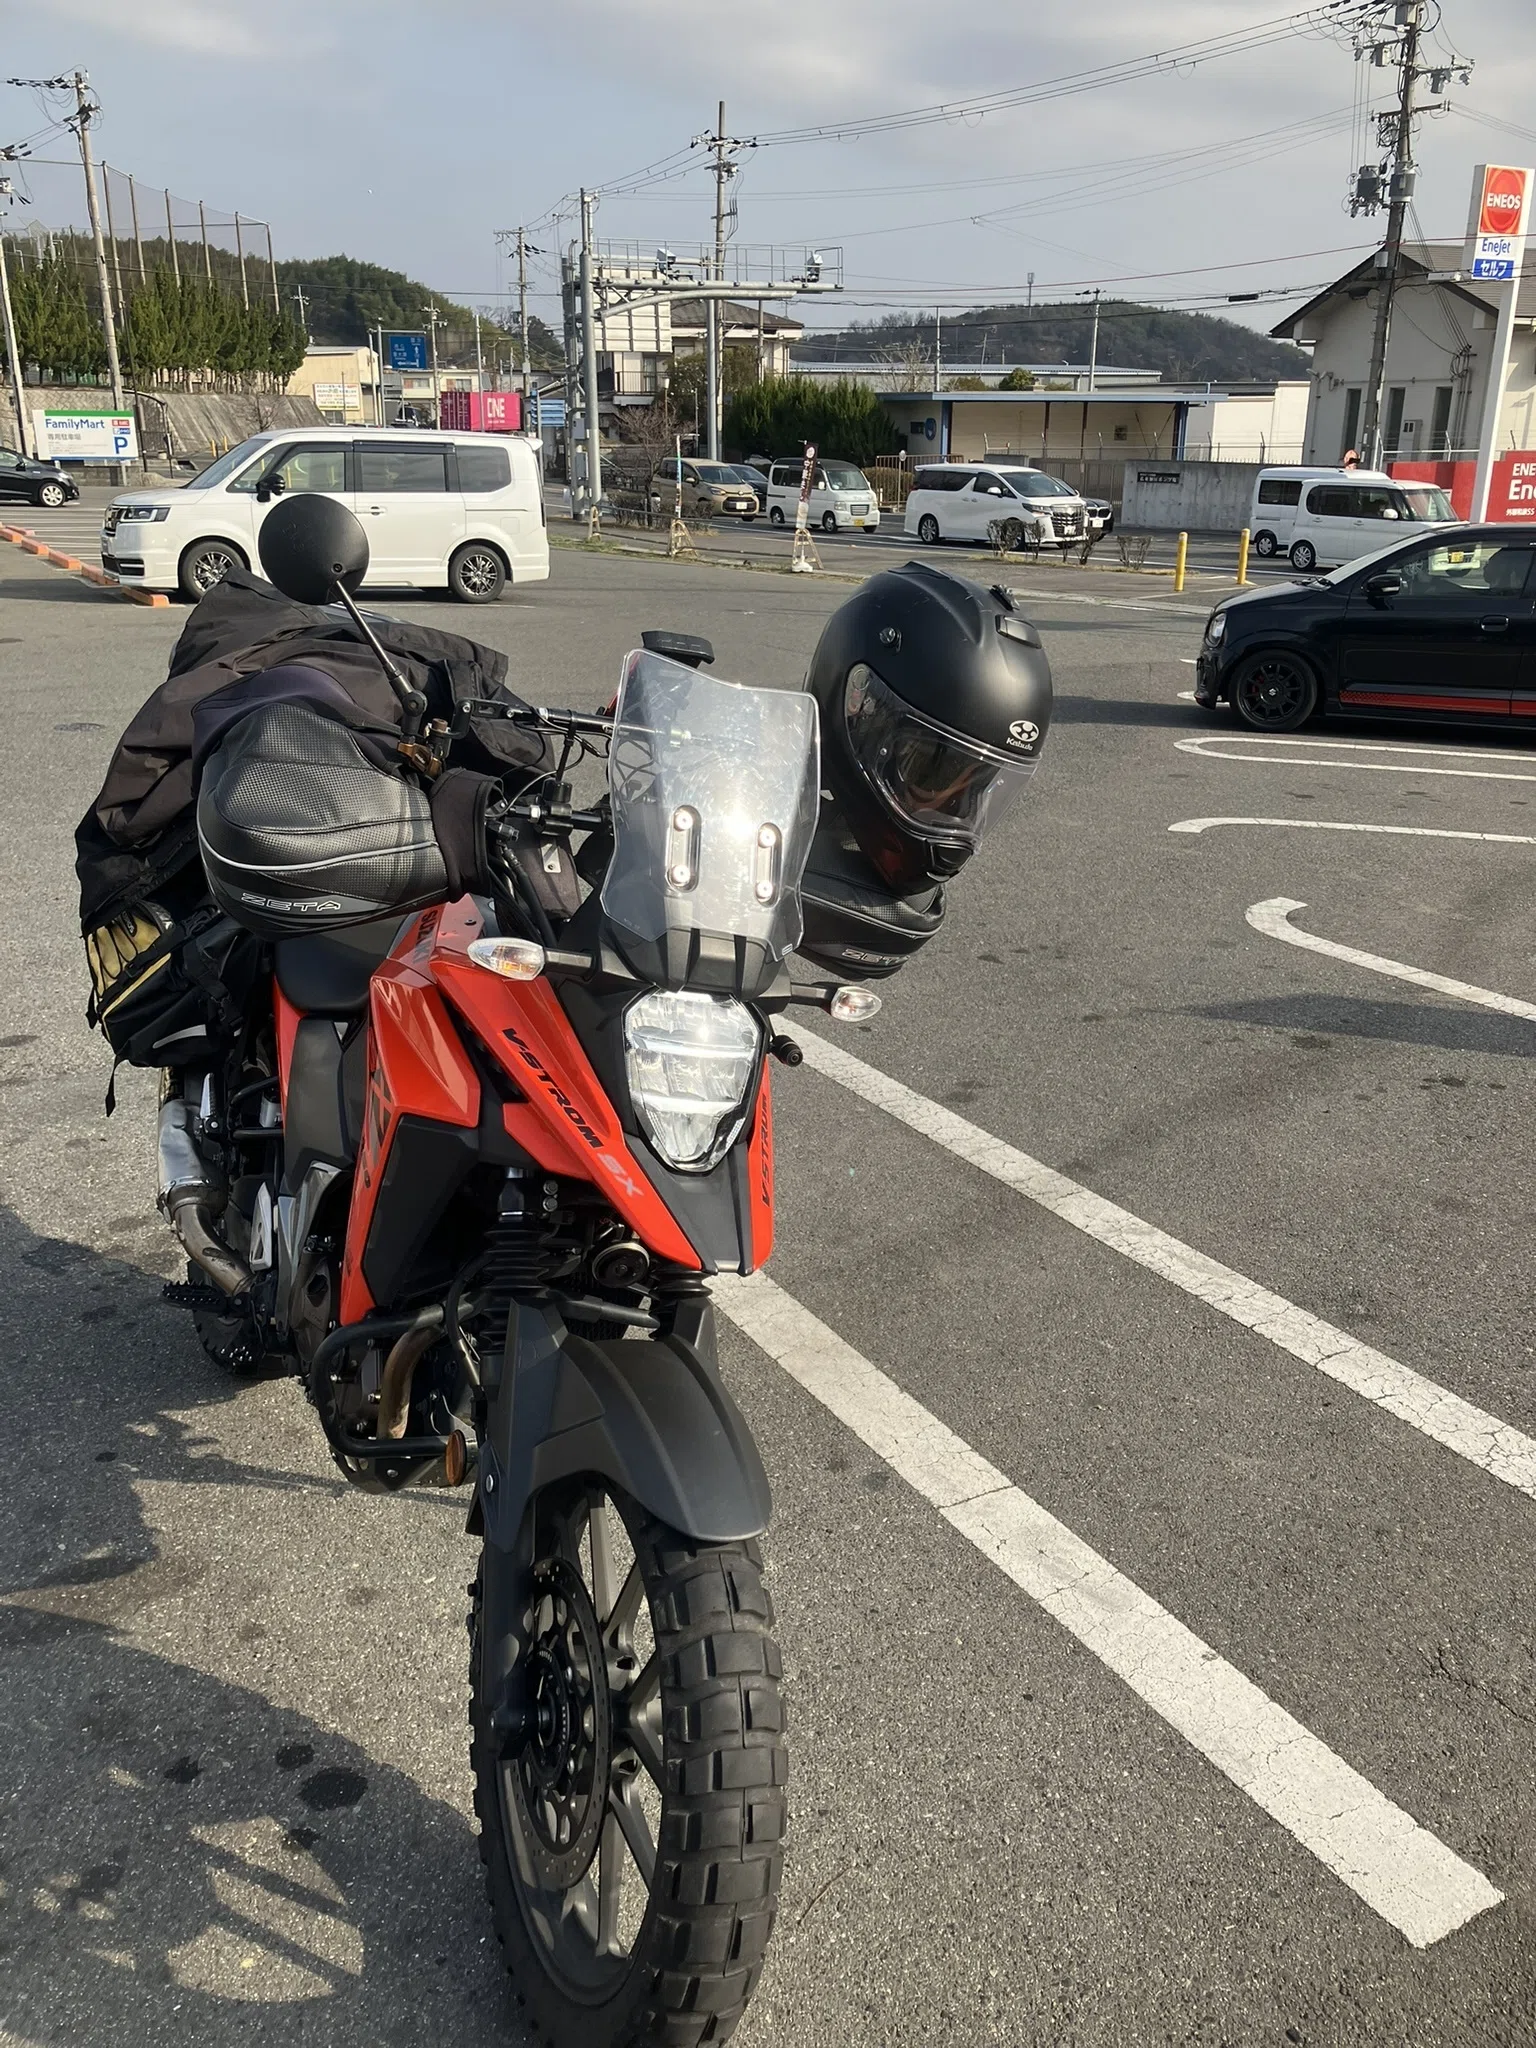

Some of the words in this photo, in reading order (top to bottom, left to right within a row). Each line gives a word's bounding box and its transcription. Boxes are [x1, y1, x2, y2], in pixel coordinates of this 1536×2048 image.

[1486, 192, 1521, 209] ENEOS
[1480, 260, 1508, 277] セルフ
[45, 418, 105, 430] FamilyMart
[113, 436, 128, 455] P
[1508, 479, 1536, 500] En
[1006, 737, 1034, 751] Kabuto
[241, 892, 341, 912] ZETA
[597, 1153, 644, 1197] SX
